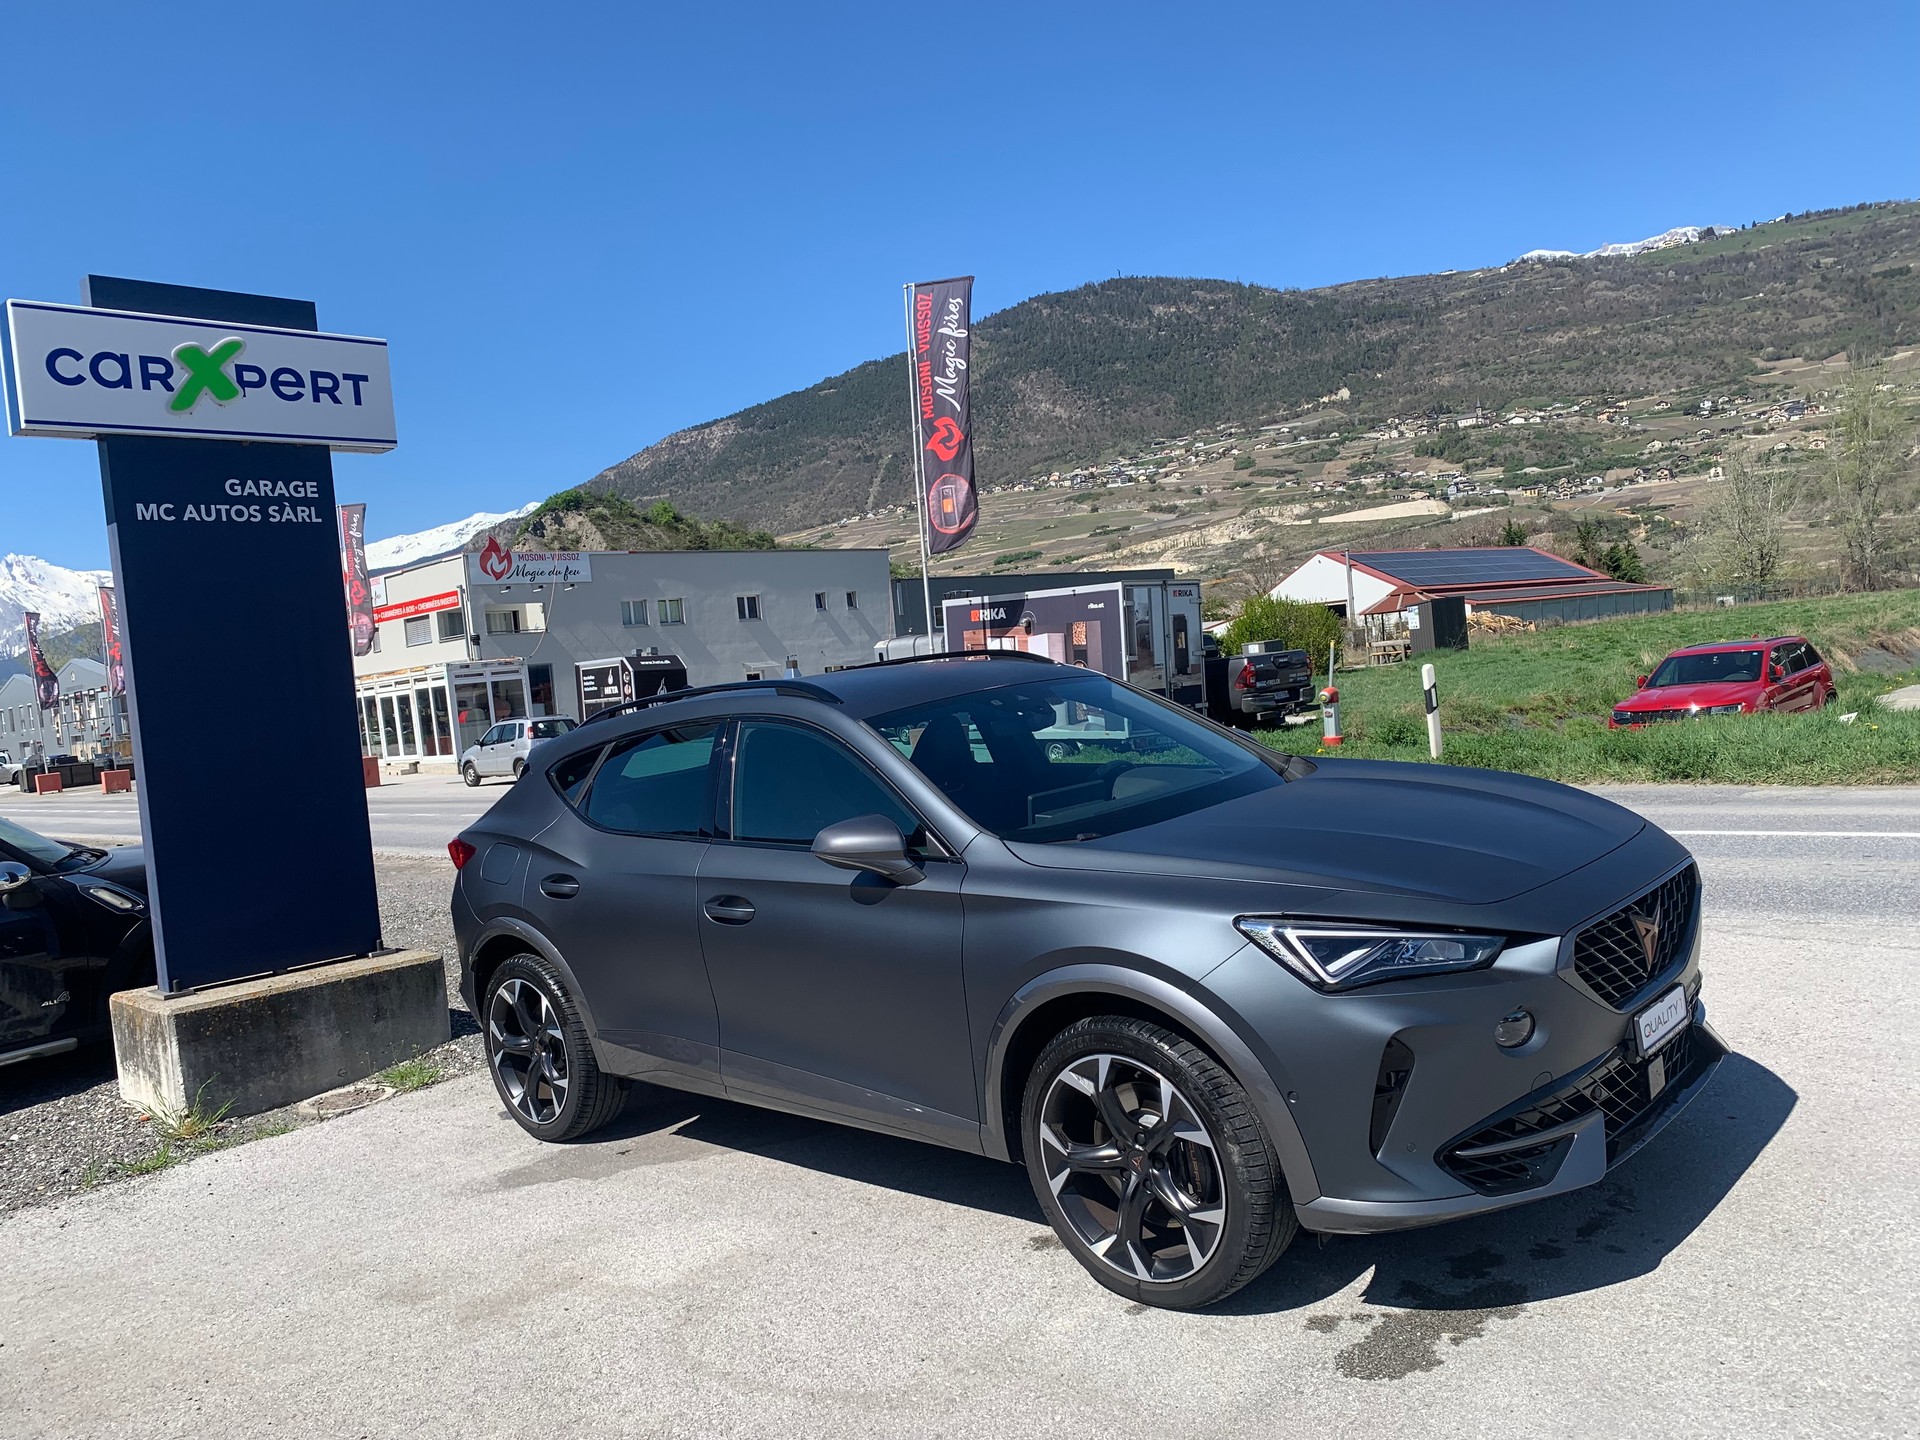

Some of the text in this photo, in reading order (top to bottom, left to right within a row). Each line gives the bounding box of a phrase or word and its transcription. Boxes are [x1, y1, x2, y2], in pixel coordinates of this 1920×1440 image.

[917, 292, 935, 420] MOSONI-VUISSOZ
[933, 297, 968, 412] Magic fires
[224, 478, 320, 498] GARAGE
[135, 501, 323, 523] MC AUTOS SÀRL
[517, 552, 581, 562] MOSONI-VUISSOZ
[506, 563, 581, 582] Magie du feu
[1178, 589, 1193, 597] RIKA
[980, 607, 1007, 621] RIKA
[604, 685, 619, 695] HETA
